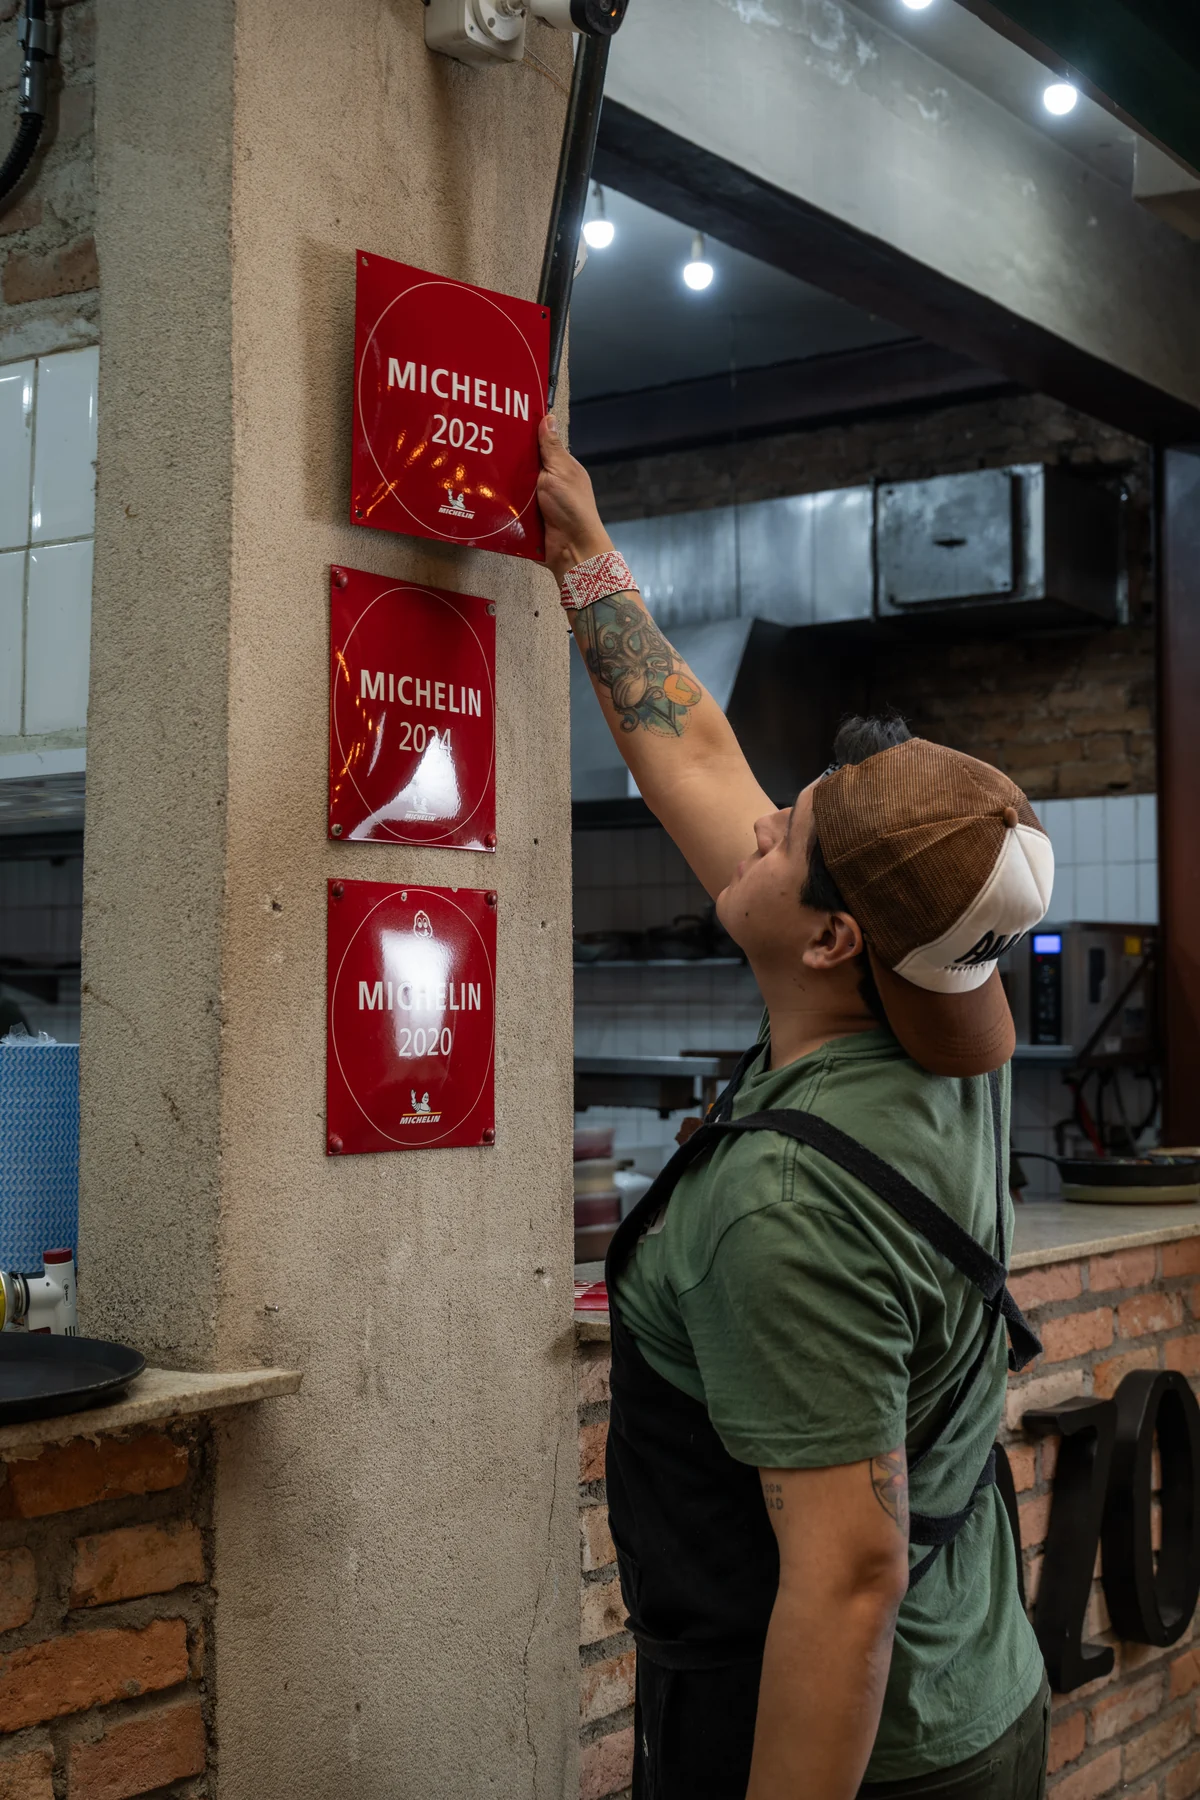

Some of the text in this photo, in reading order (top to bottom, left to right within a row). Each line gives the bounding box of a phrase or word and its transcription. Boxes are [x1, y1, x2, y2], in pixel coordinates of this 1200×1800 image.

[387, 356, 530, 422] MICHELIN
[431, 413, 494, 455] 2025
[438, 506, 475, 519] MICHELIN
[360, 669, 482, 718] MICHELIN
[398, 1027, 452, 1057] 2020
[400, 1114, 441, 1125] MICHELIN
